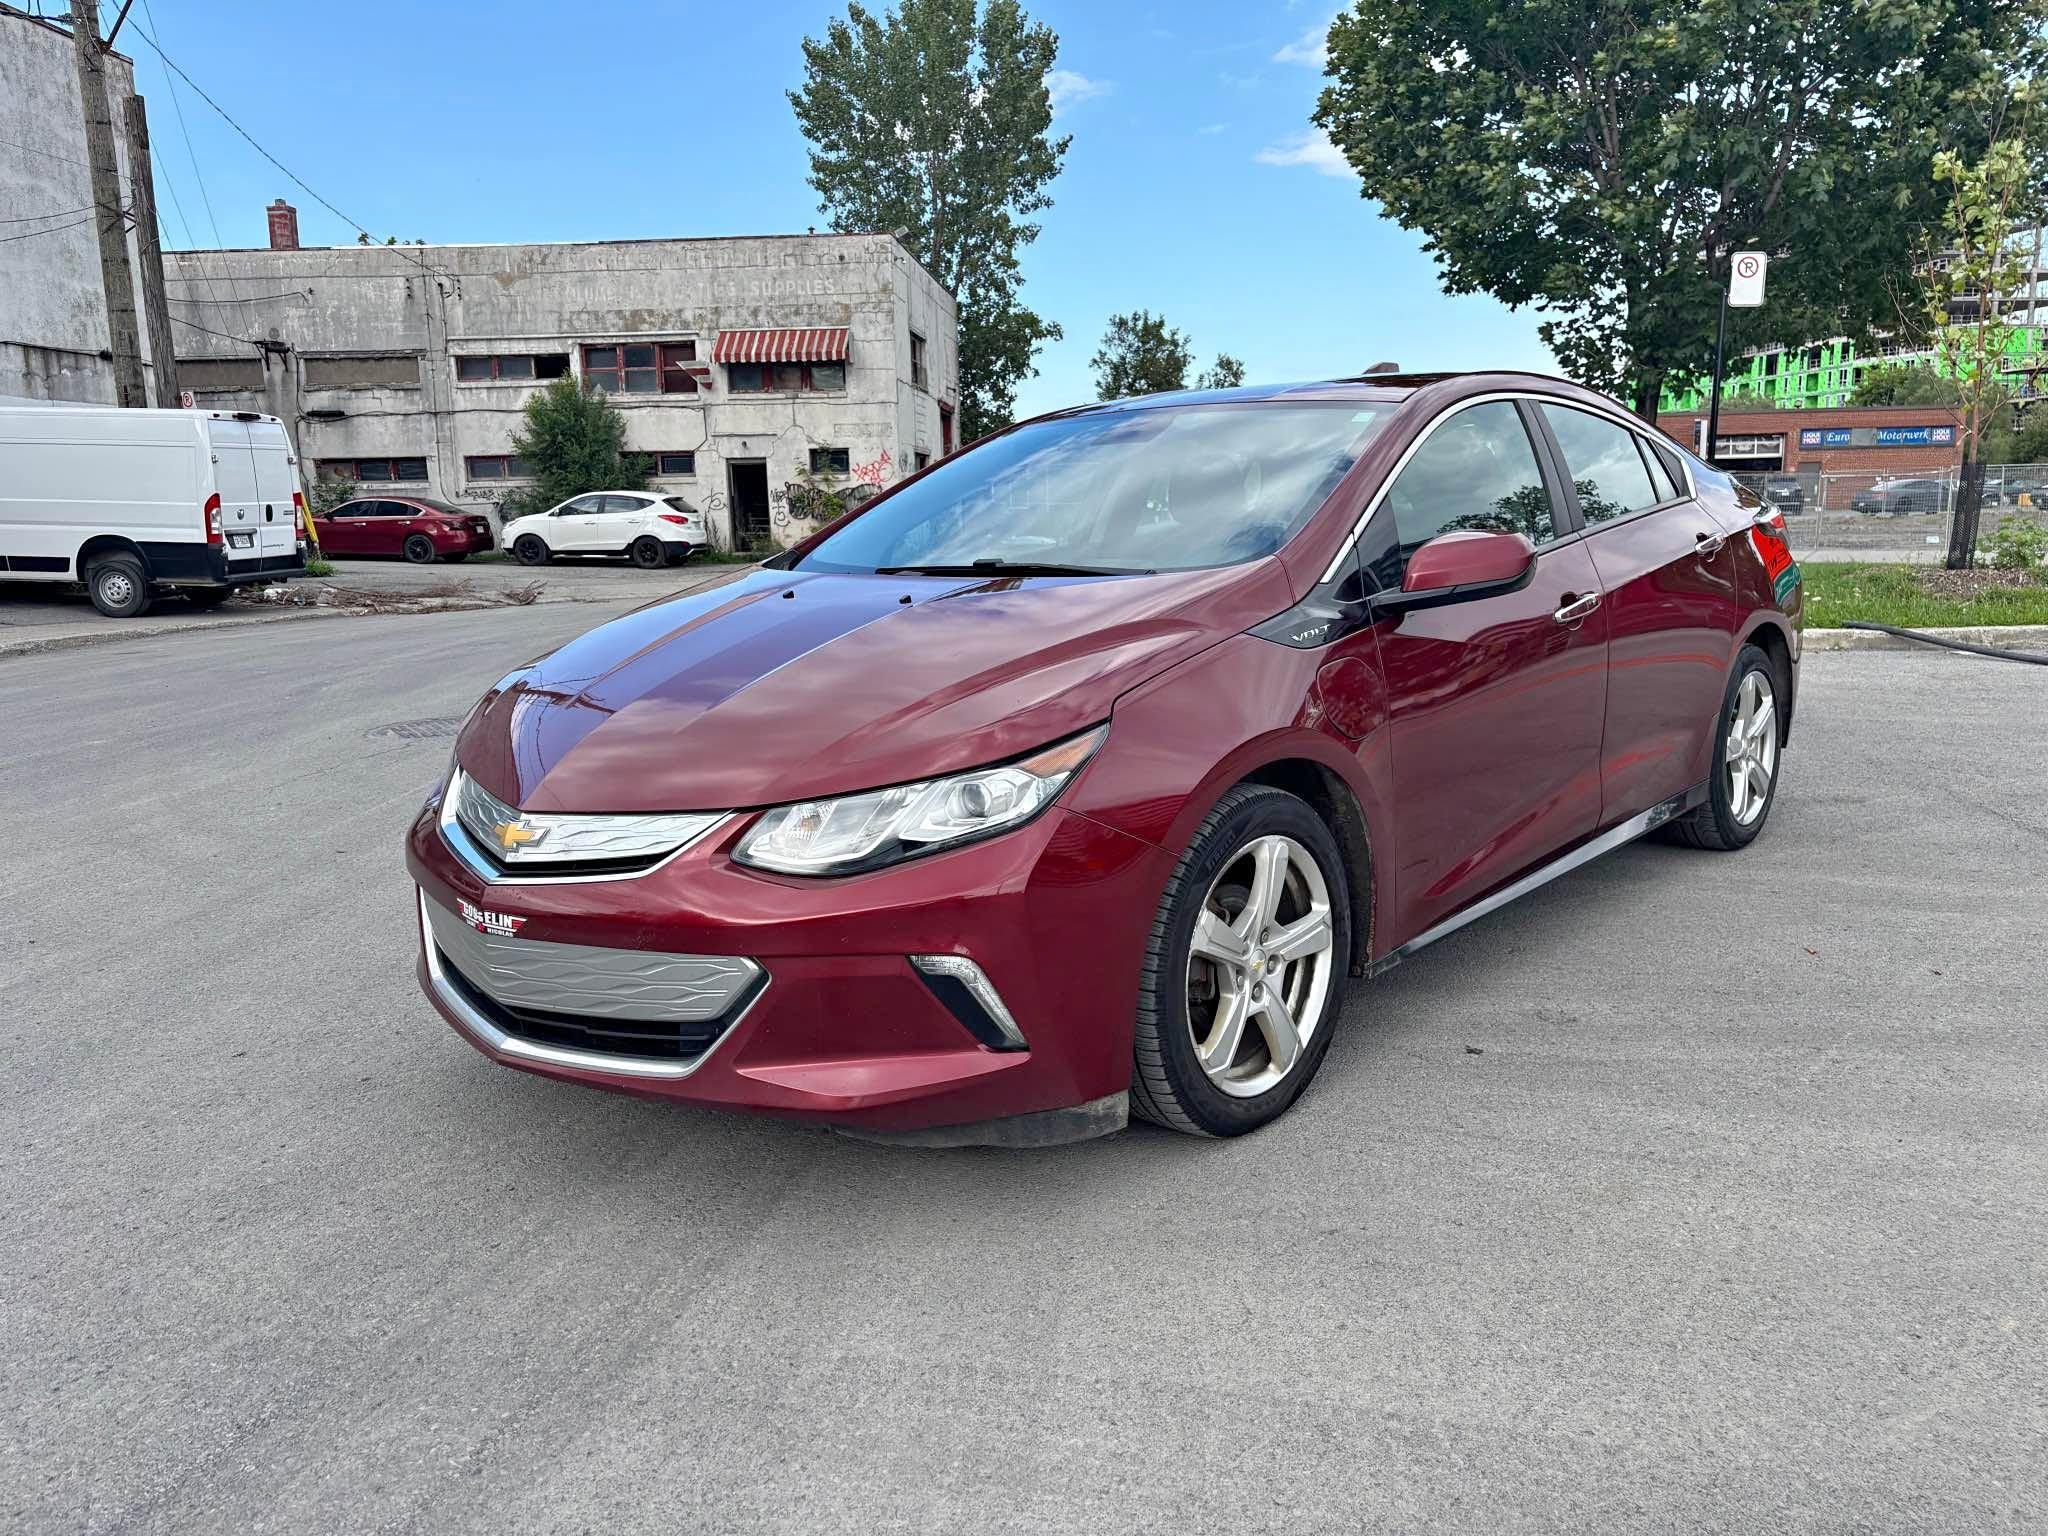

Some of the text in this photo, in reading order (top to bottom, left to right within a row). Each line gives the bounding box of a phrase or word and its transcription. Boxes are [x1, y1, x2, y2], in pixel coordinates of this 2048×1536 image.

[1745, 261, 1754, 273] P
[1826, 430, 1929, 442] Euro Motorwerk
[1291, 623, 1331, 643] VOLT
